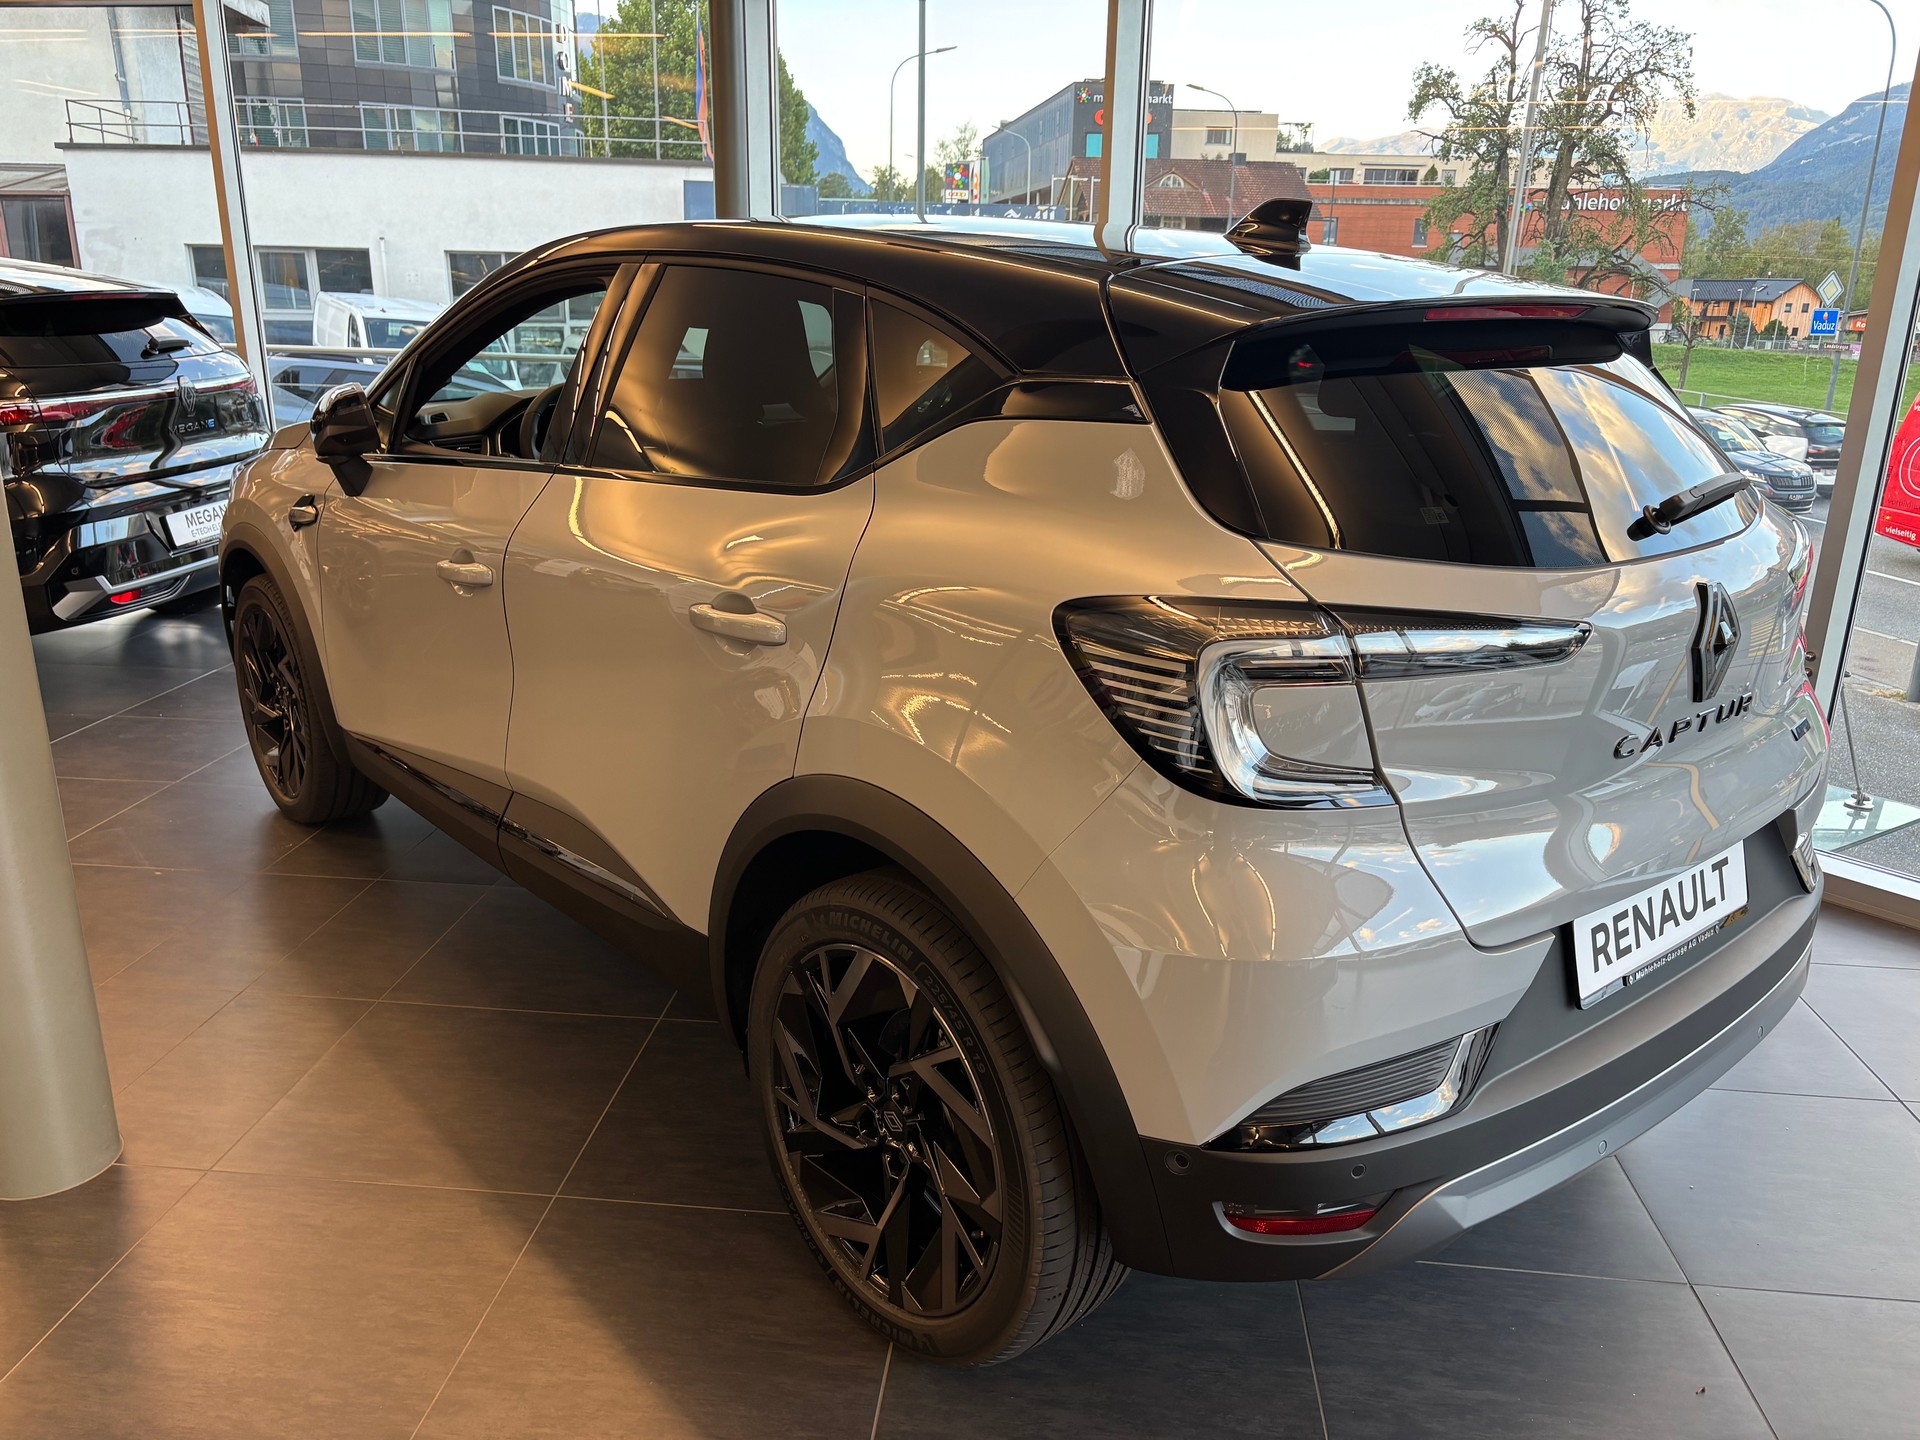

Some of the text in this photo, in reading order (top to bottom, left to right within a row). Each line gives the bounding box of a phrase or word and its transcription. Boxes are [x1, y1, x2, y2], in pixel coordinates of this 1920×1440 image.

[1813, 319, 1836, 331] Vaduz
[168, 418, 215, 434] MEGANE
[1885, 526, 1917, 541] vielseitig
[1612, 691, 1753, 759] CAPTUR
[828, 911, 914, 962] MICHELIN
[1590, 856, 1729, 974] RENAULT
[1635, 929, 1715, 981] Mühleholz-Garage AG Vaduz
[923, 975, 987, 1074] 225/45 R 19
